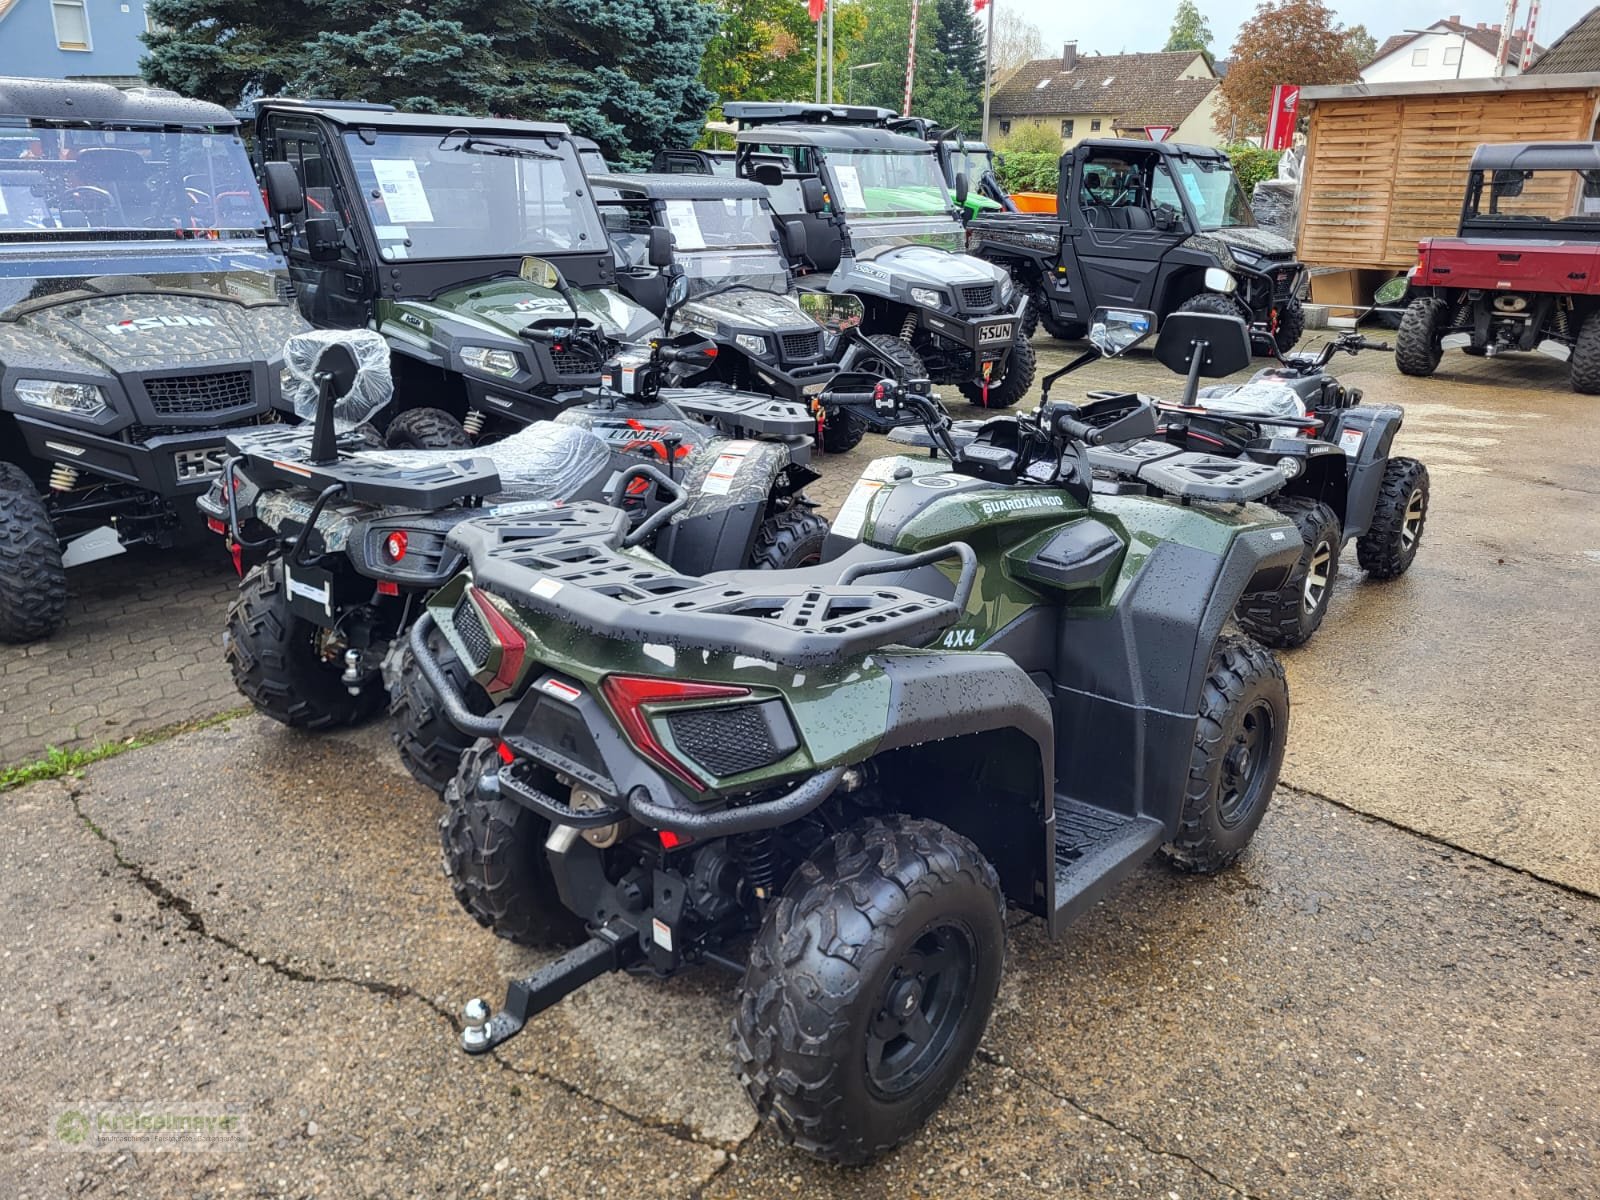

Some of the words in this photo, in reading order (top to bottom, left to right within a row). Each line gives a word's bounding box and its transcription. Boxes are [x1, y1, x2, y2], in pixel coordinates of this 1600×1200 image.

[104, 315, 216, 335] HSUN
[980, 325, 1010, 340] HSUN
[983, 497, 1042, 514] GUARDIAN
[1042, 496, 1064, 506] 400
[943, 629, 975, 648] 4X4
